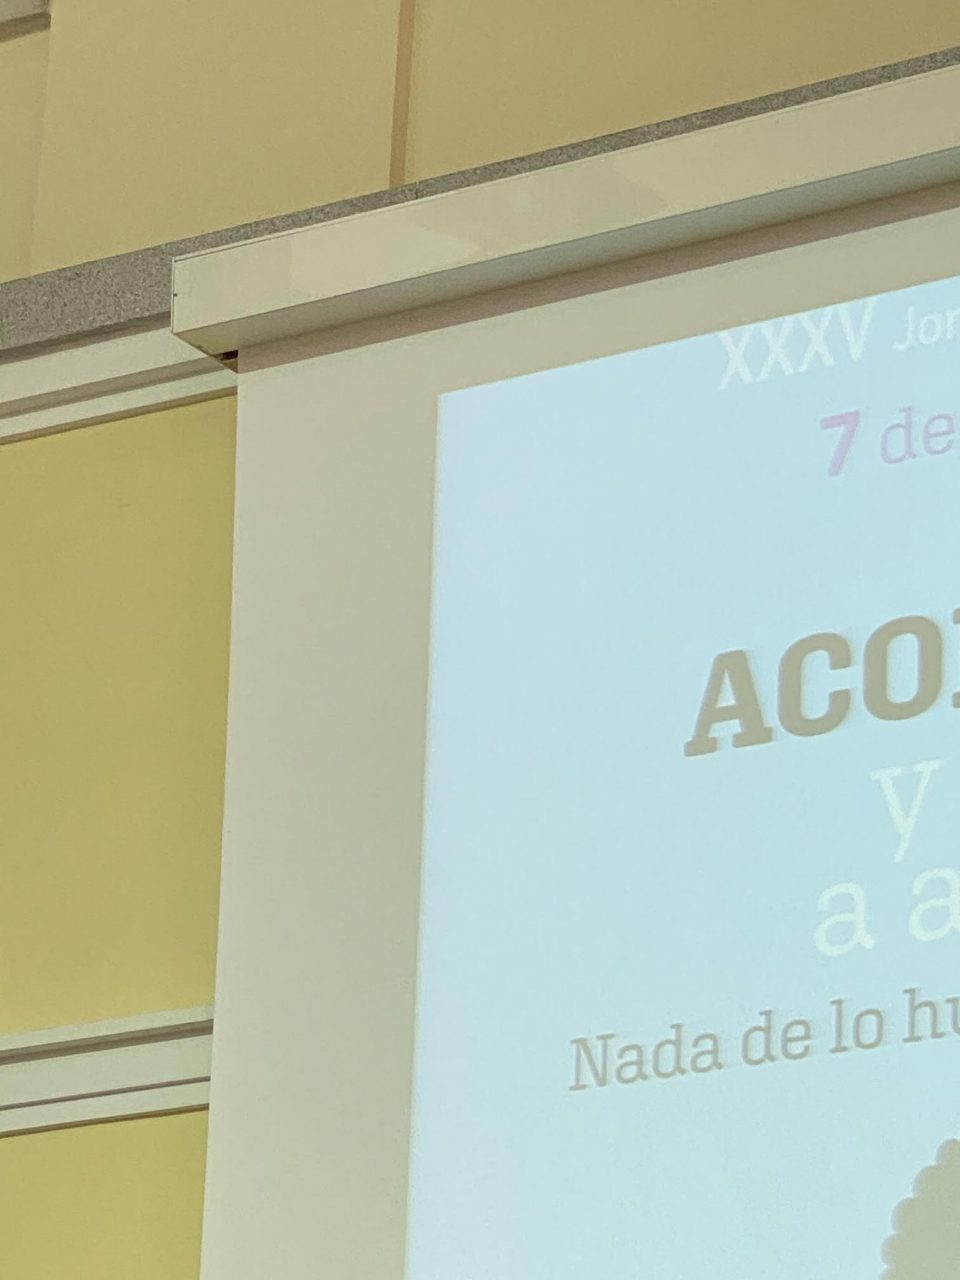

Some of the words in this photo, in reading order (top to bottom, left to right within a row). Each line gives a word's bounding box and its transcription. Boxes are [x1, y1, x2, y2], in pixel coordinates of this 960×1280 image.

[717, 296, 878, 391] XXXV
[820, 409, 860, 477] 7
[880, 406, 957, 465] de
[870, 758, 945, 863] y
[812, 881, 875, 956] a
[568, 1024, 723, 1091] Nada
[741, 1010, 812, 1066] de
[829, 999, 885, 1054] lo
